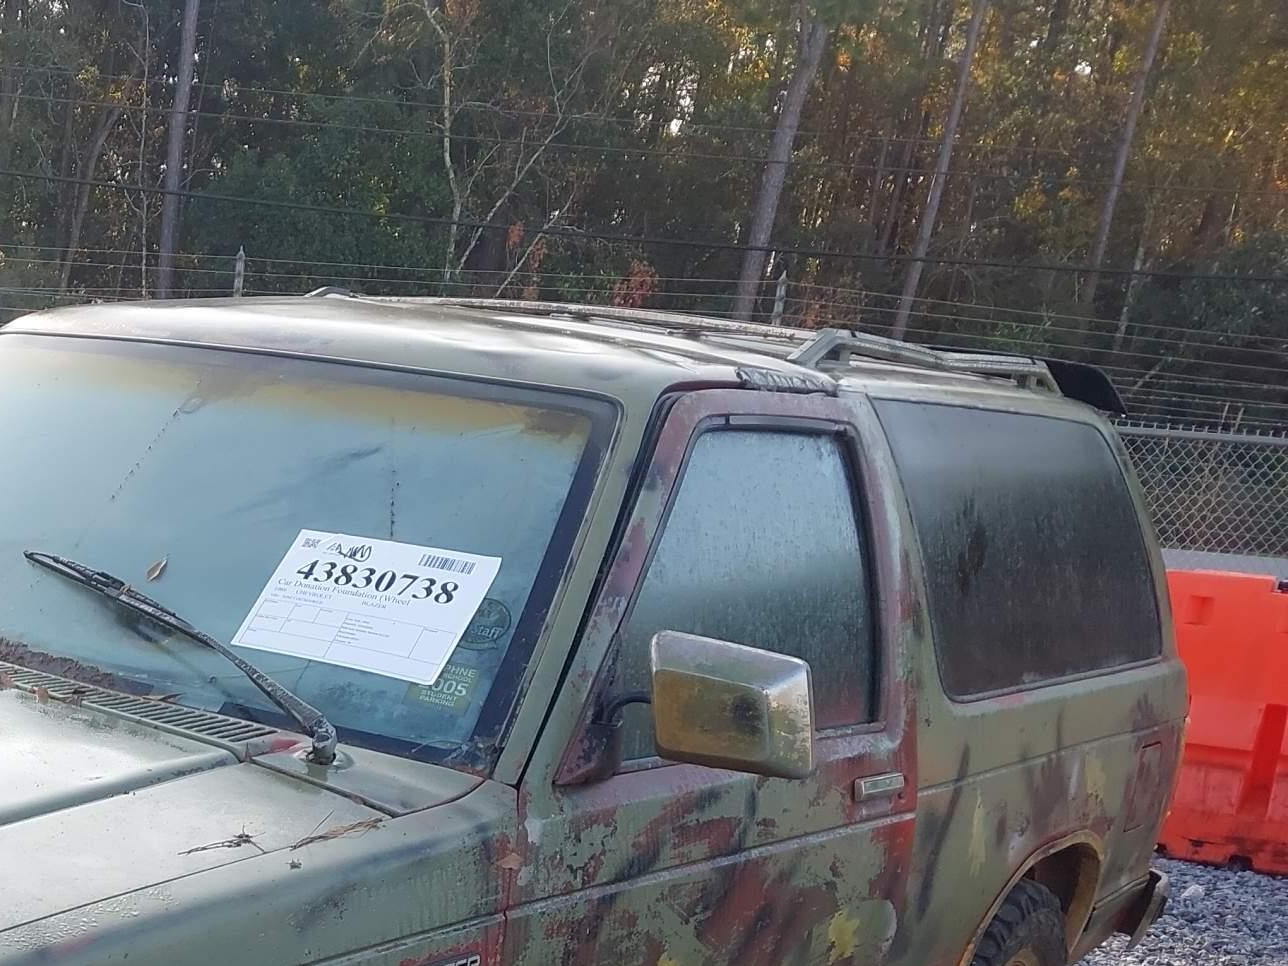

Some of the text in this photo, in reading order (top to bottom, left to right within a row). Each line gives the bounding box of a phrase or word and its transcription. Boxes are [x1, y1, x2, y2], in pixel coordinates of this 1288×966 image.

[278, 578, 293, 586] Car
[294, 580, 331, 592] Donation
[331, 586, 378, 600] Foundation
[296, 560, 459, 604] 43830738
[444, 664, 478, 679] PHNE
[418, 678, 470, 697] 005
